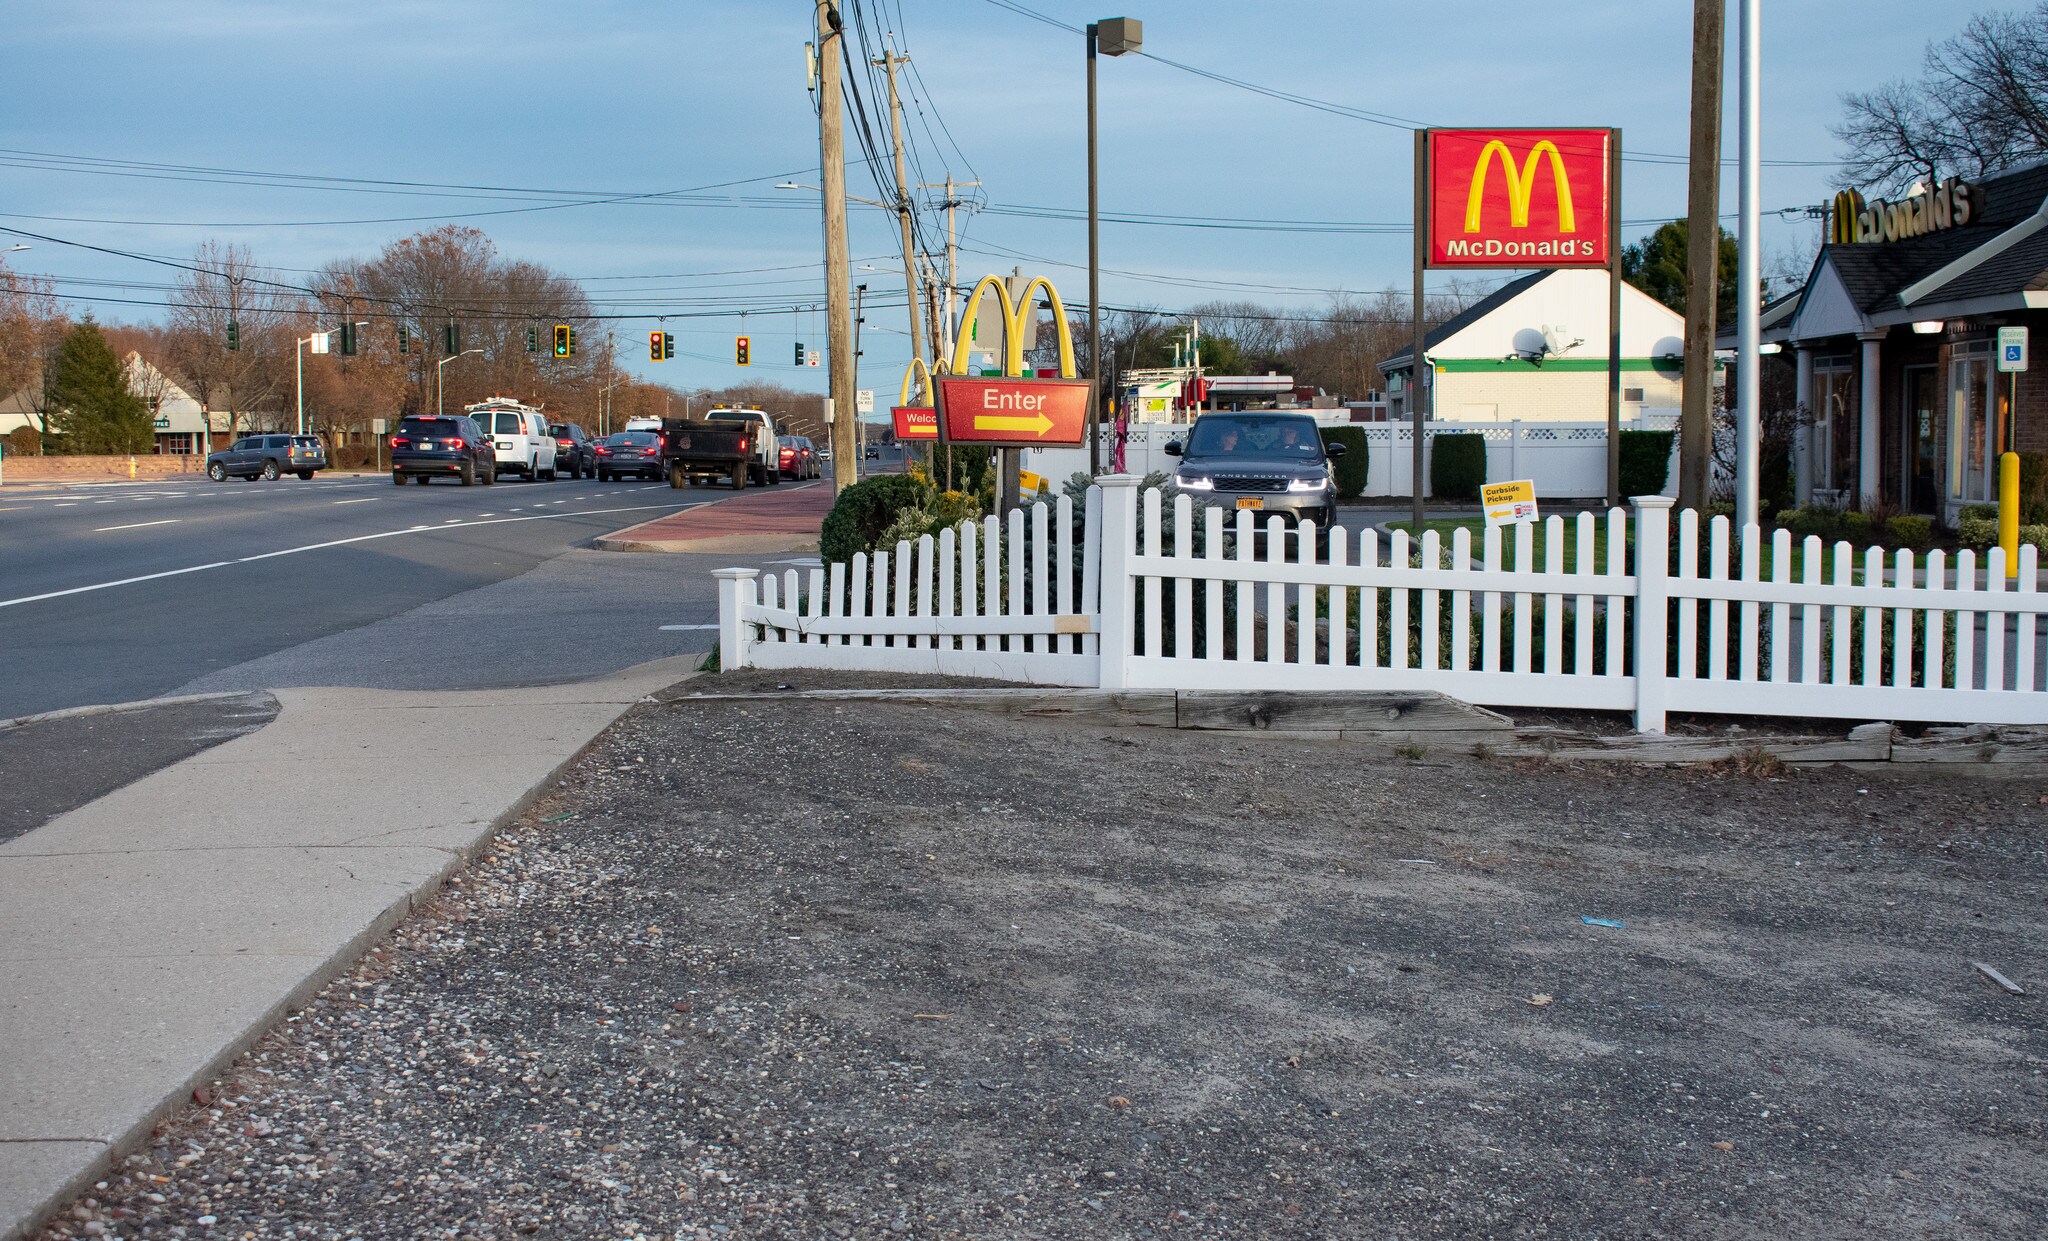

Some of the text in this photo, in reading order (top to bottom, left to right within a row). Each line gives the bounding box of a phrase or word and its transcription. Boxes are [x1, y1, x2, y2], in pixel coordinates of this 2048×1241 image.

[1831, 176, 1970, 244] McDonald's
[1447, 239, 1594, 257] McDonald's
[983, 388, 1047, 411] Enter
[906, 413, 937, 423] Welco
[1486, 485, 1520, 495] Curbside
[1487, 495, 1513, 503] Pickup
